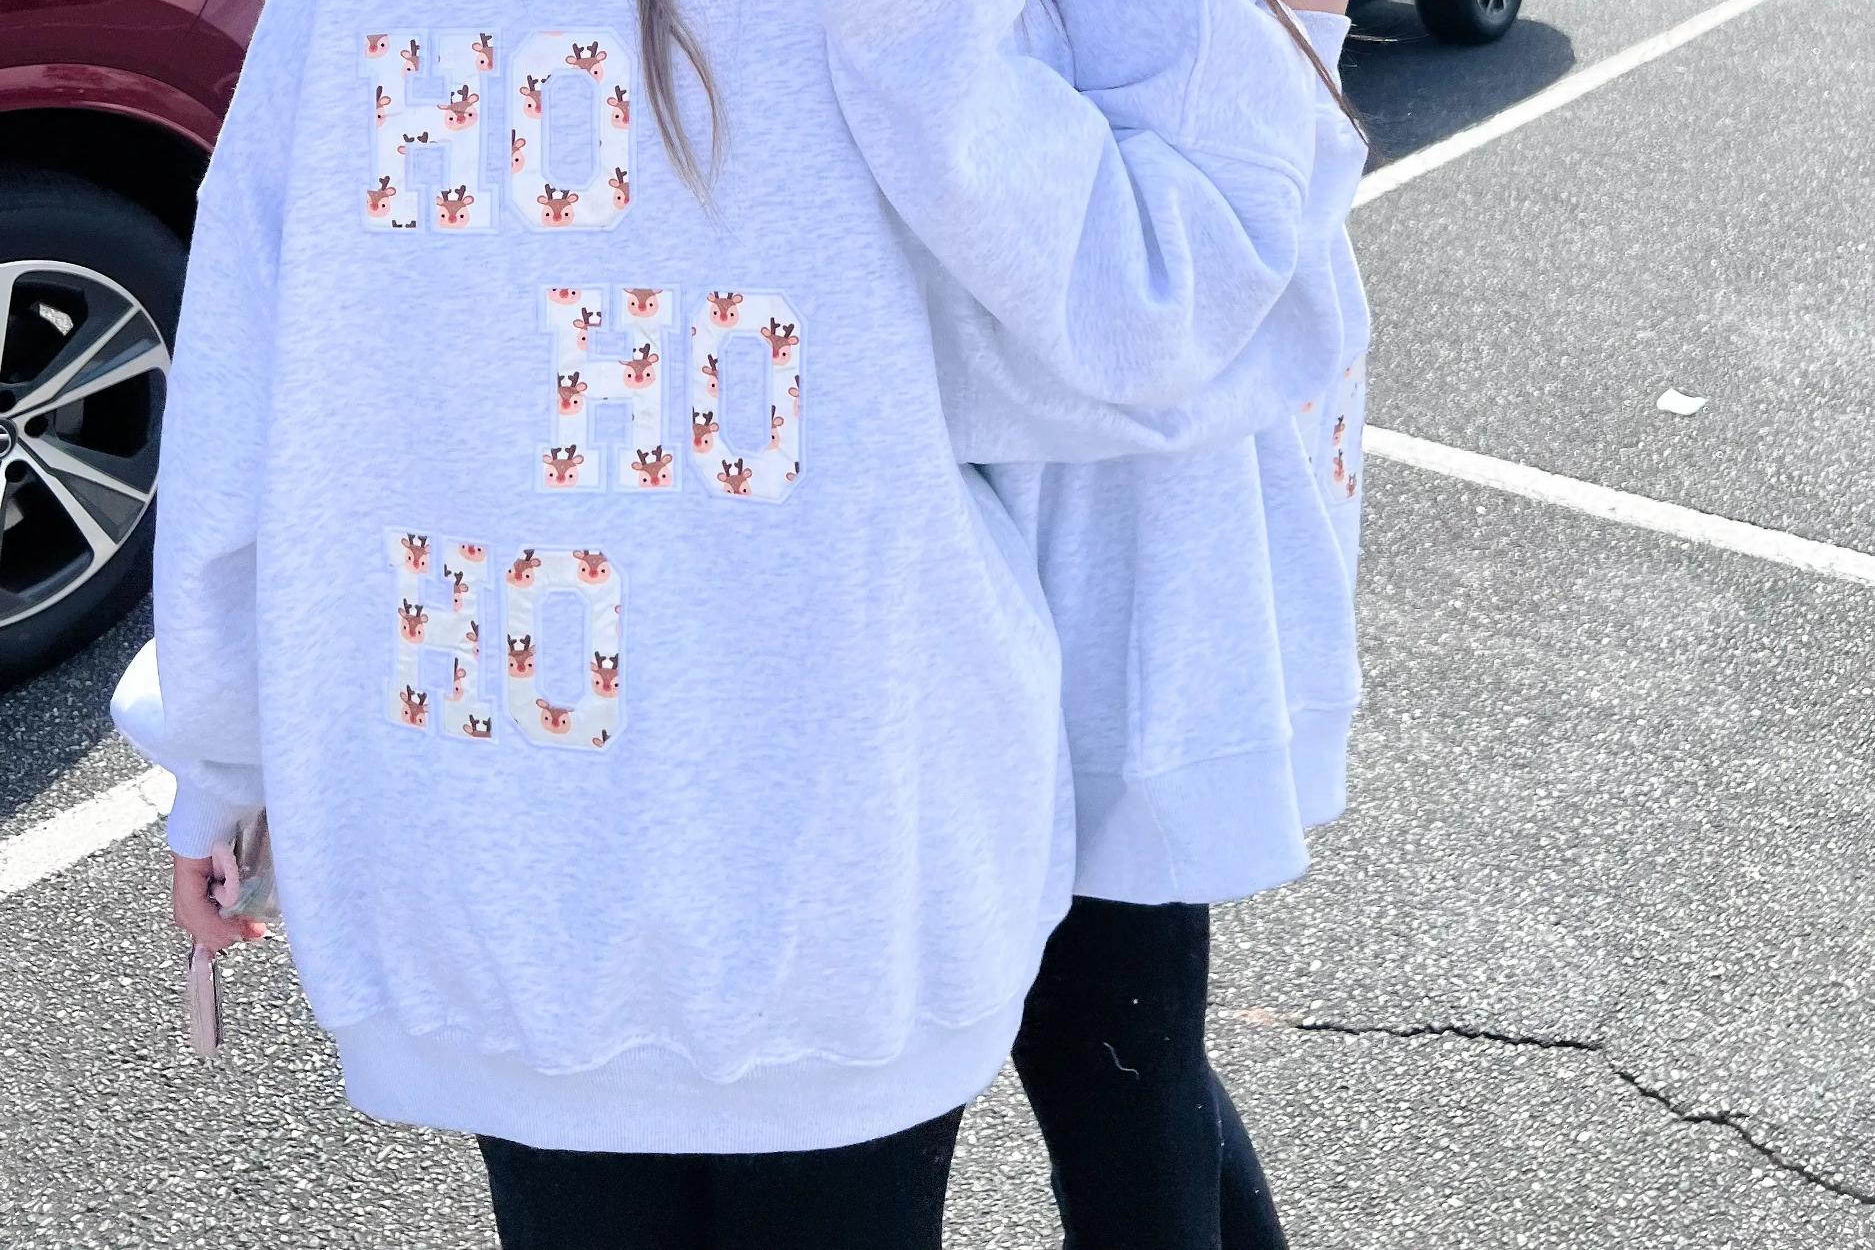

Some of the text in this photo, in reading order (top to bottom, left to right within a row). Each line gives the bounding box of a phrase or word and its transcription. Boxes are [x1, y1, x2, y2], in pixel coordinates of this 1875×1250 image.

[360, 28, 637, 232] HO
[537, 284, 806, 504] HO
[385, 526, 628, 749] HO
